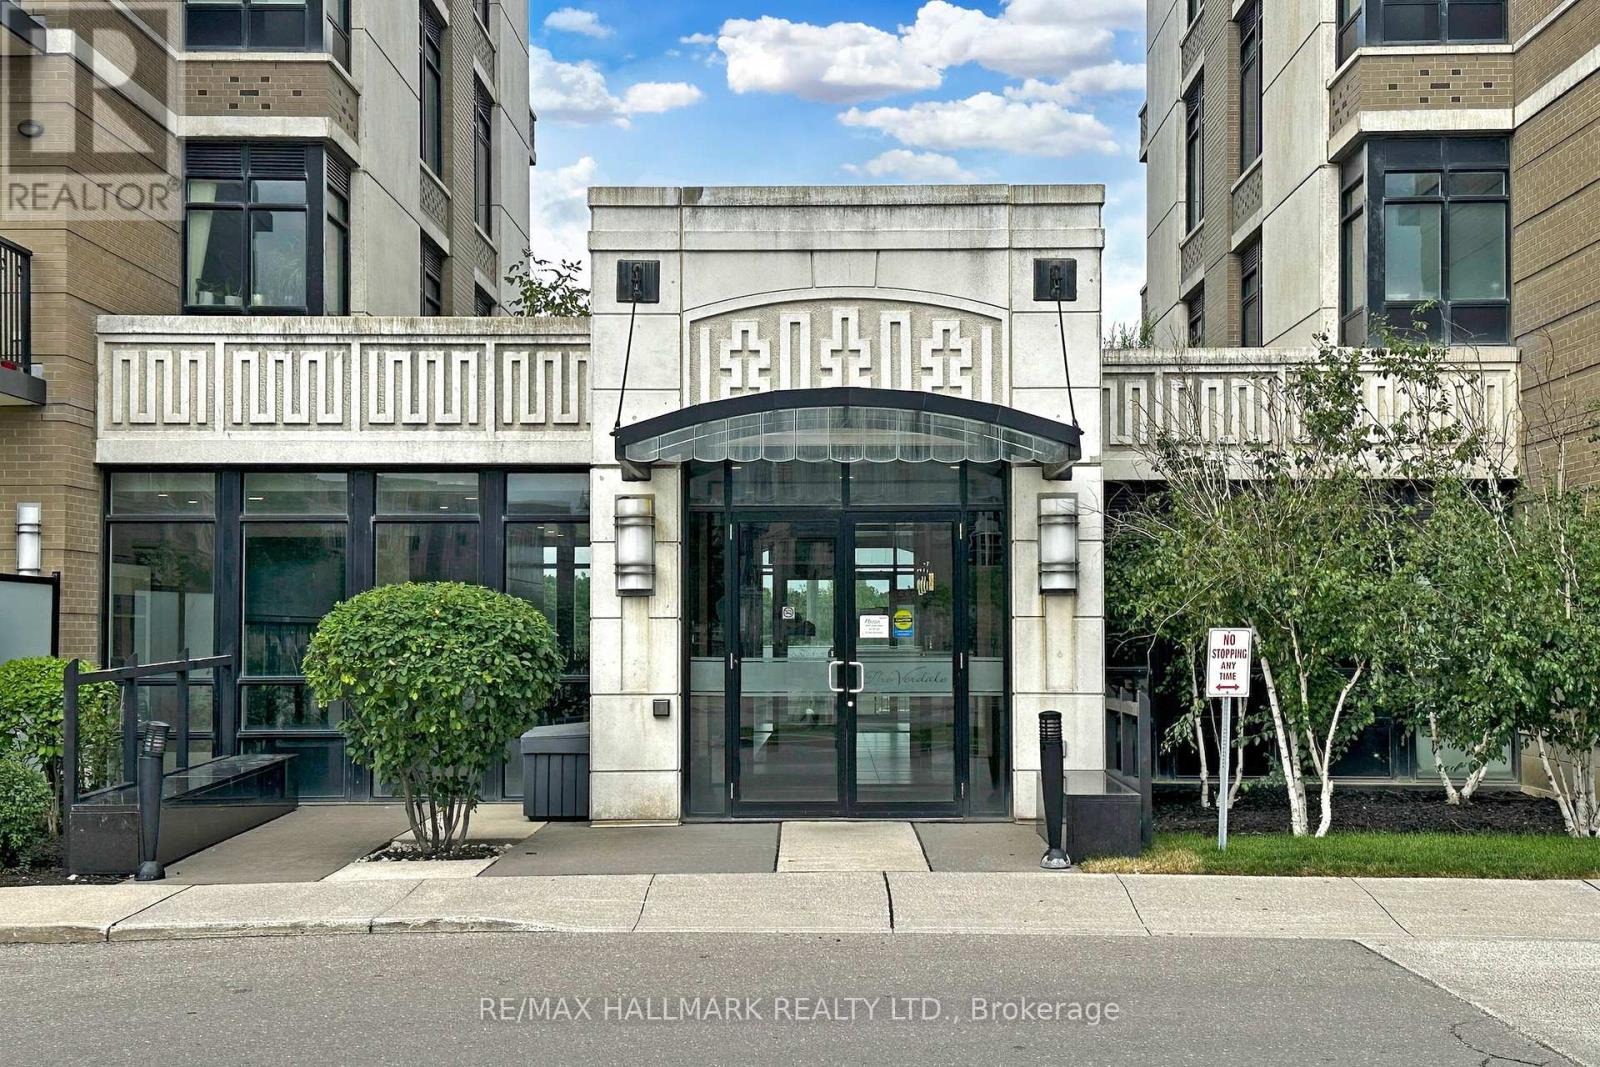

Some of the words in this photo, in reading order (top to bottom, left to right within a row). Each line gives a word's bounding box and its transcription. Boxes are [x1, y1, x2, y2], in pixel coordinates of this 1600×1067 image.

[1223, 633, 1236, 646] NO
[1211, 648, 1247, 660] STOPPING
[1220, 661, 1237, 670] ANY
[1219, 672, 1237, 681] TIME
